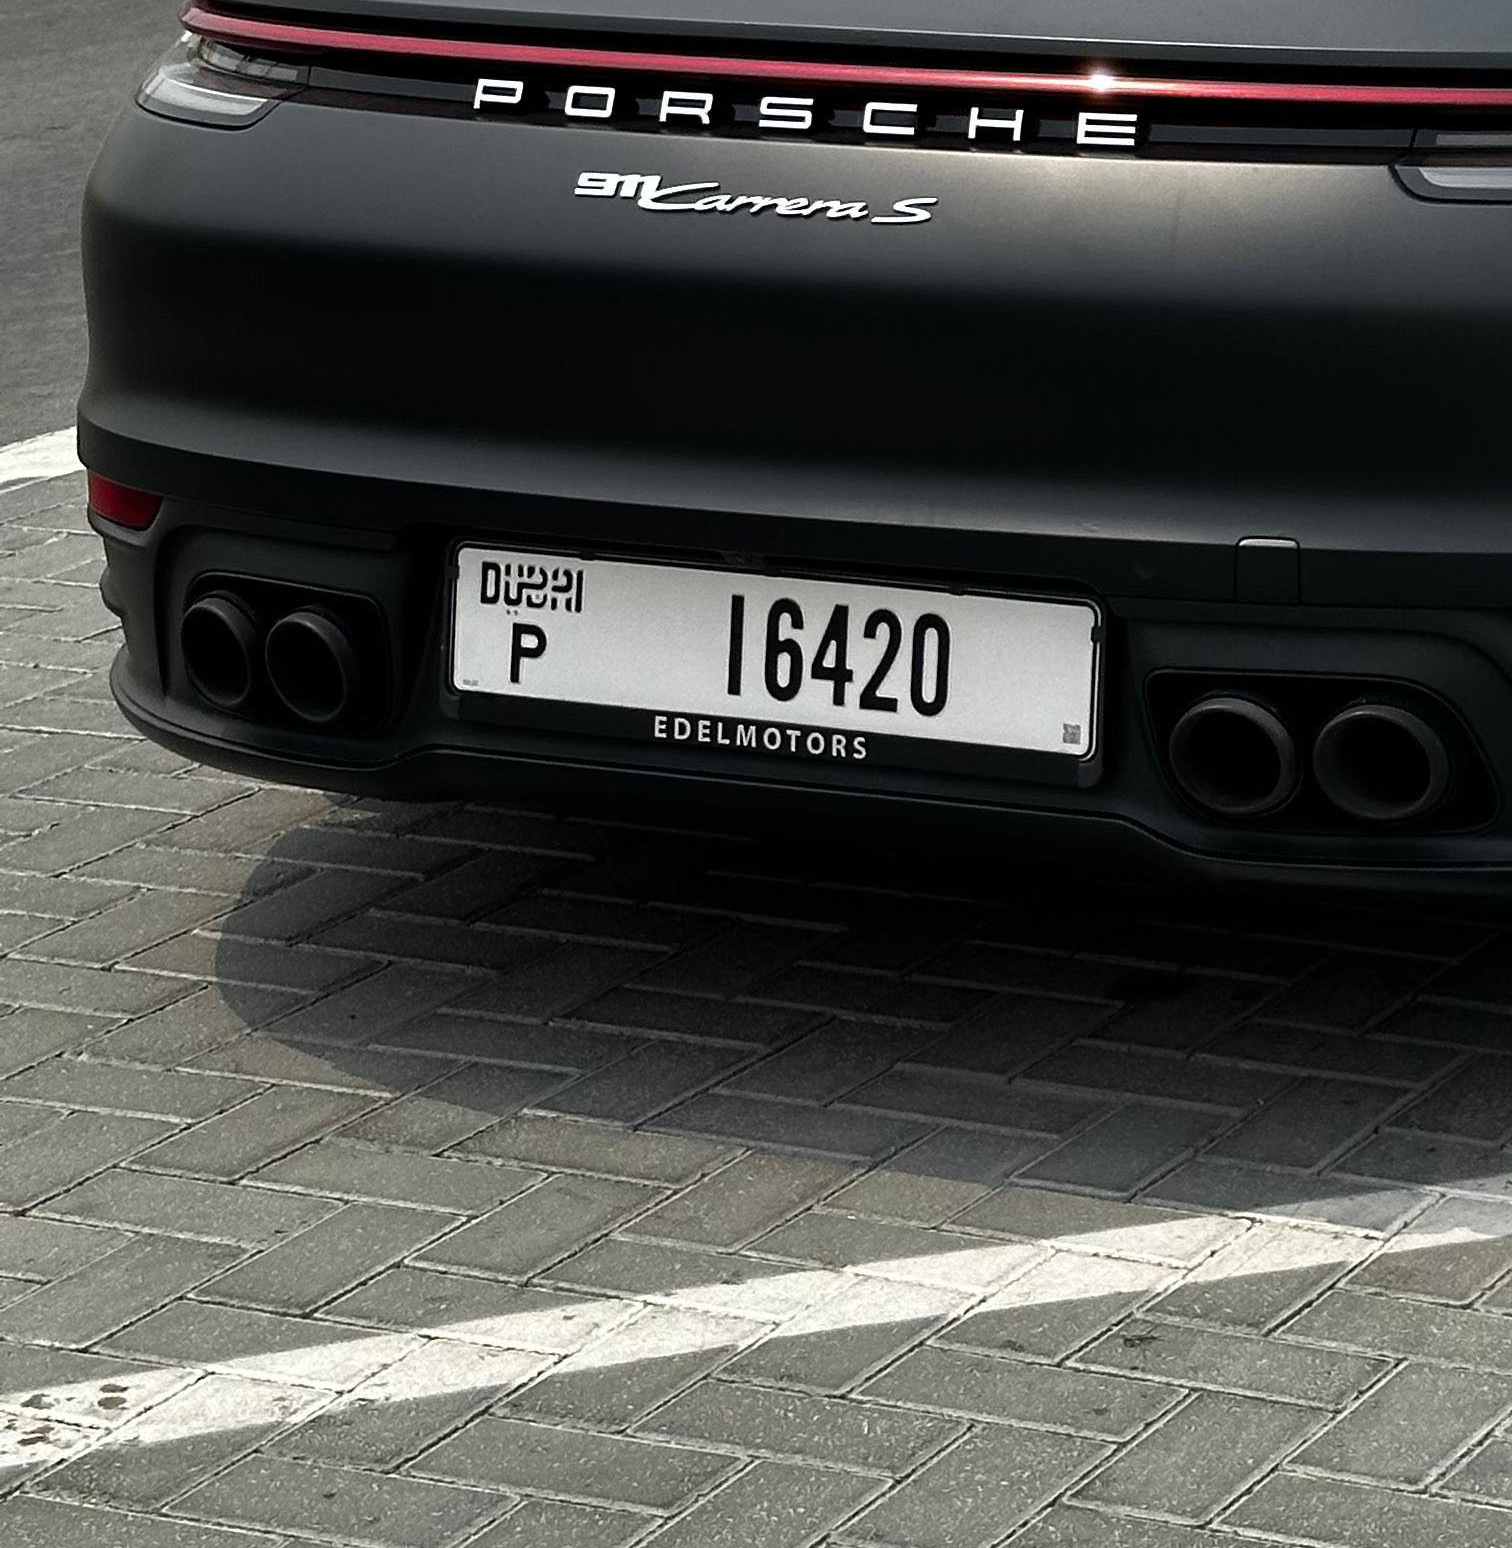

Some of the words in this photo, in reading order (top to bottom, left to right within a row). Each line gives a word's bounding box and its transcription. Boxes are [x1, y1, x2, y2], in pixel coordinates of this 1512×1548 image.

[473, 78, 1138, 146] PORSCHE
[871, 197, 938, 223] S
[510, 622, 548, 684] P
[727, 593, 951, 718] 16420
[654, 715, 868, 760] EDELMOTORS
